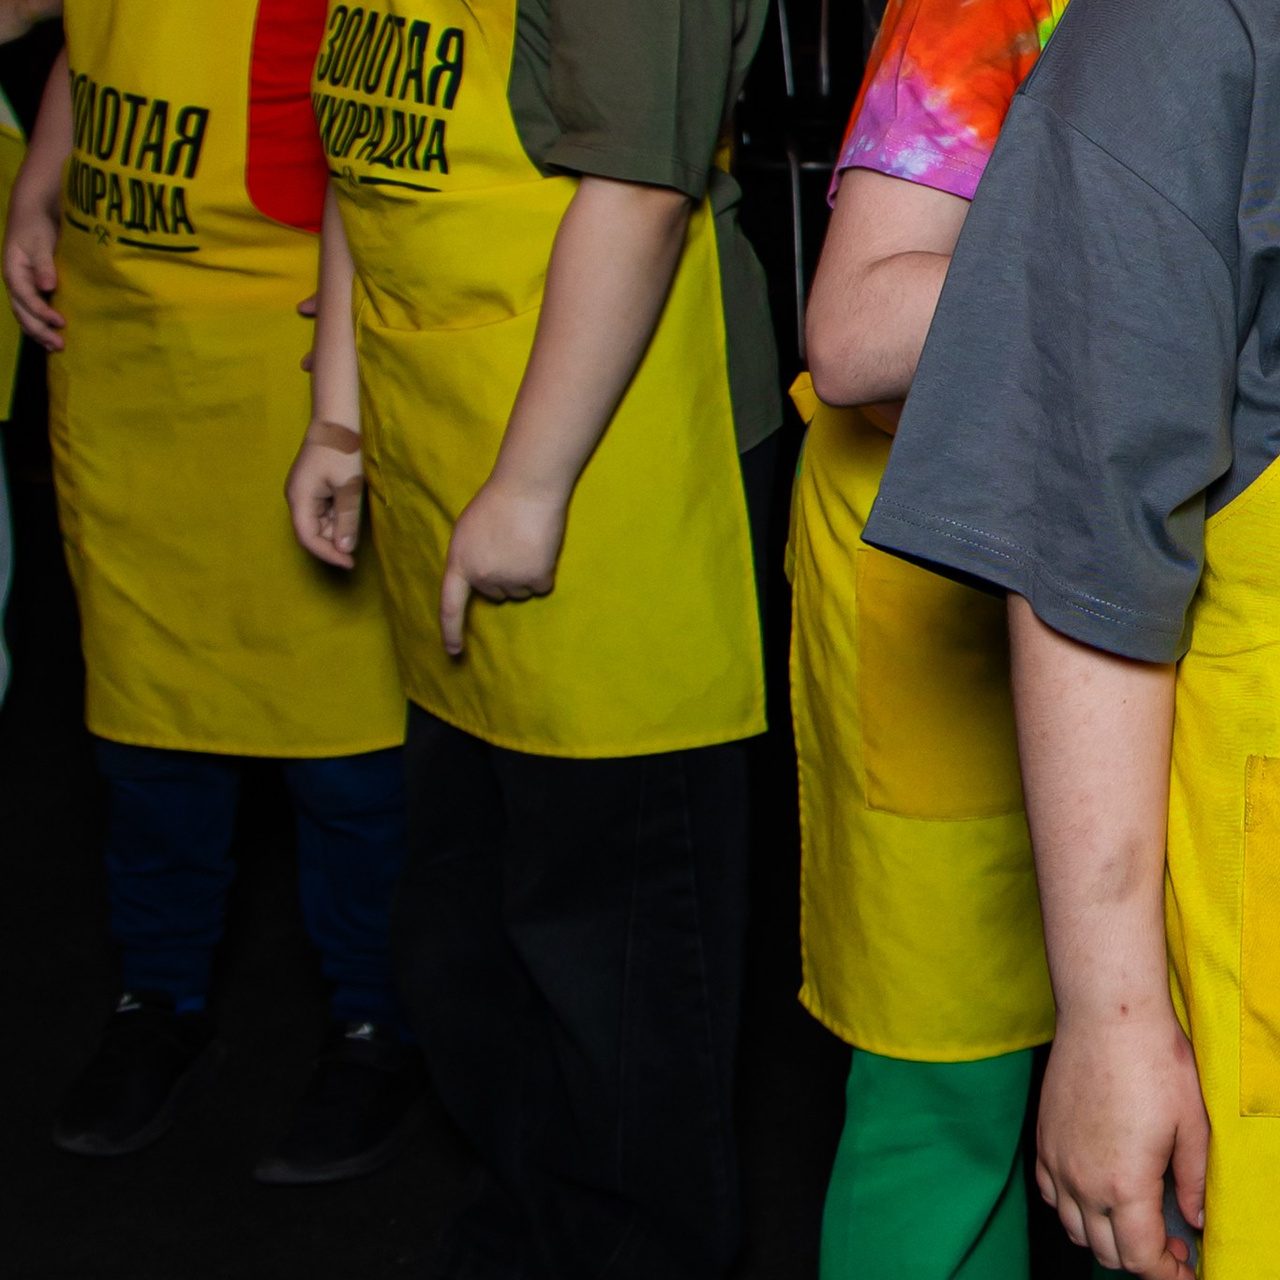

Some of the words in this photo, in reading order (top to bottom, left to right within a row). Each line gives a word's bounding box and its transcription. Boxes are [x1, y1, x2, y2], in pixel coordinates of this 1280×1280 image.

[317, 4, 464, 111] ЗОЛОТАЯ
[69, 68, 210, 180] ОЛОТАЯ
[313, 92, 448, 175] ИХОРАДКА
